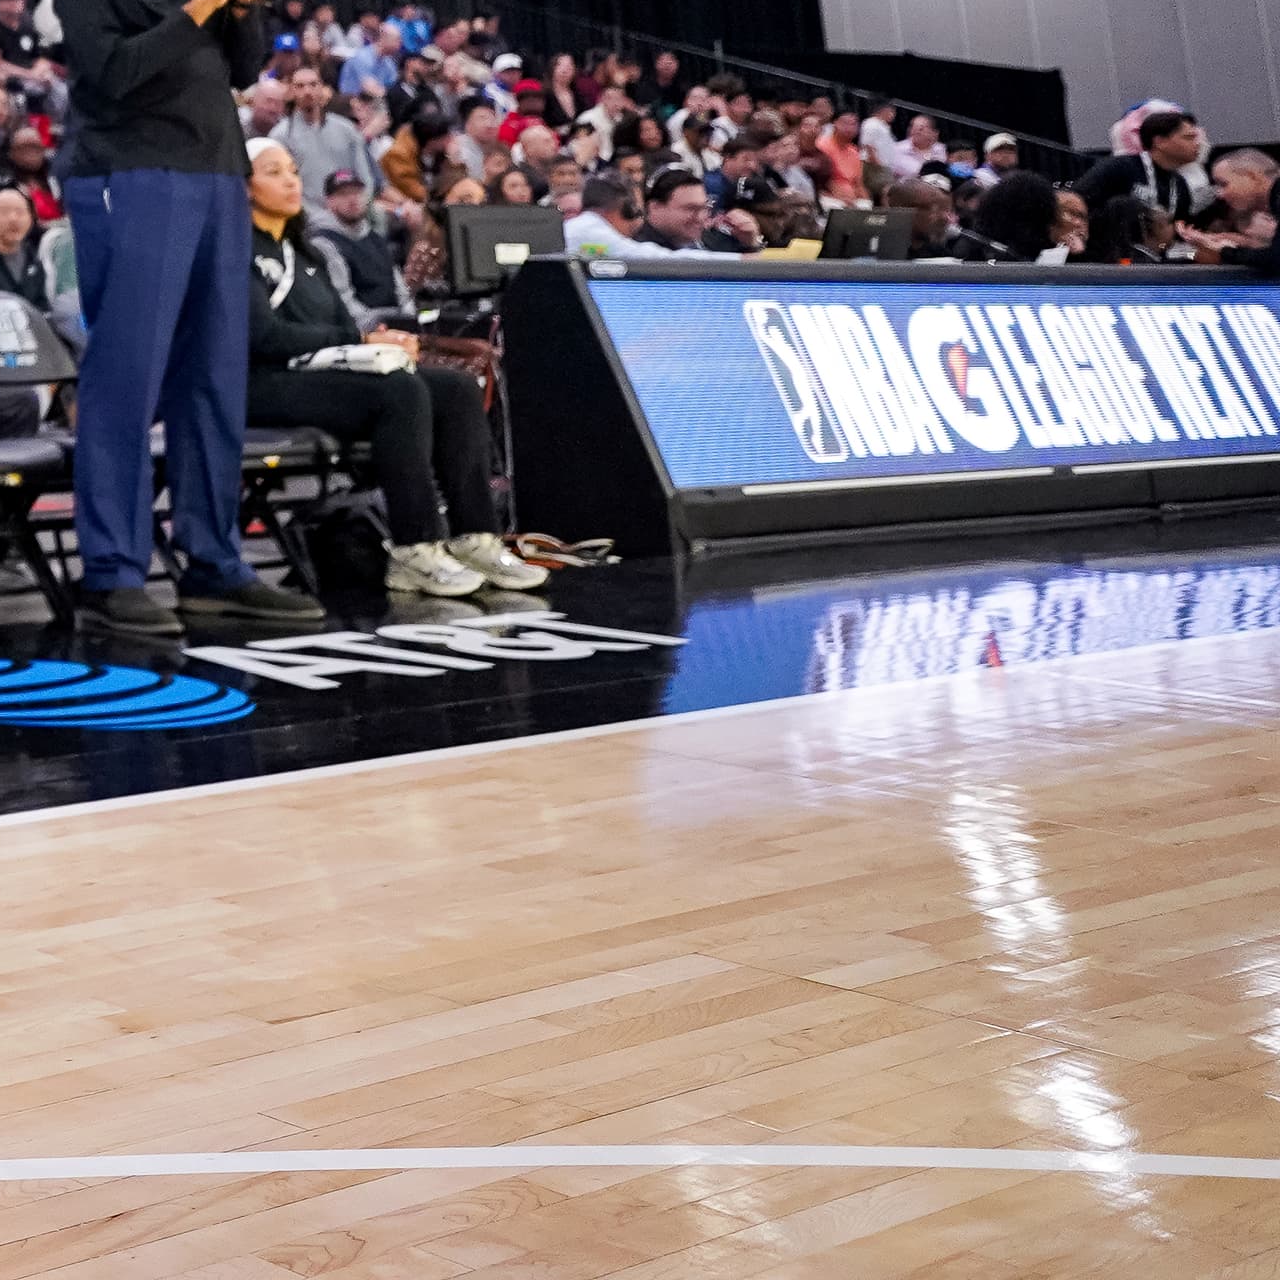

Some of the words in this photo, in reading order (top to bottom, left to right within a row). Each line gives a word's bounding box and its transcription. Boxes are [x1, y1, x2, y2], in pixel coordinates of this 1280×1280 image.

[788, 303, 957, 459] NBA
[963, 303, 1182, 450] LEAGUE
[1117, 304, 1279, 442] NEXT
[182, 610, 693, 691] AT&T
